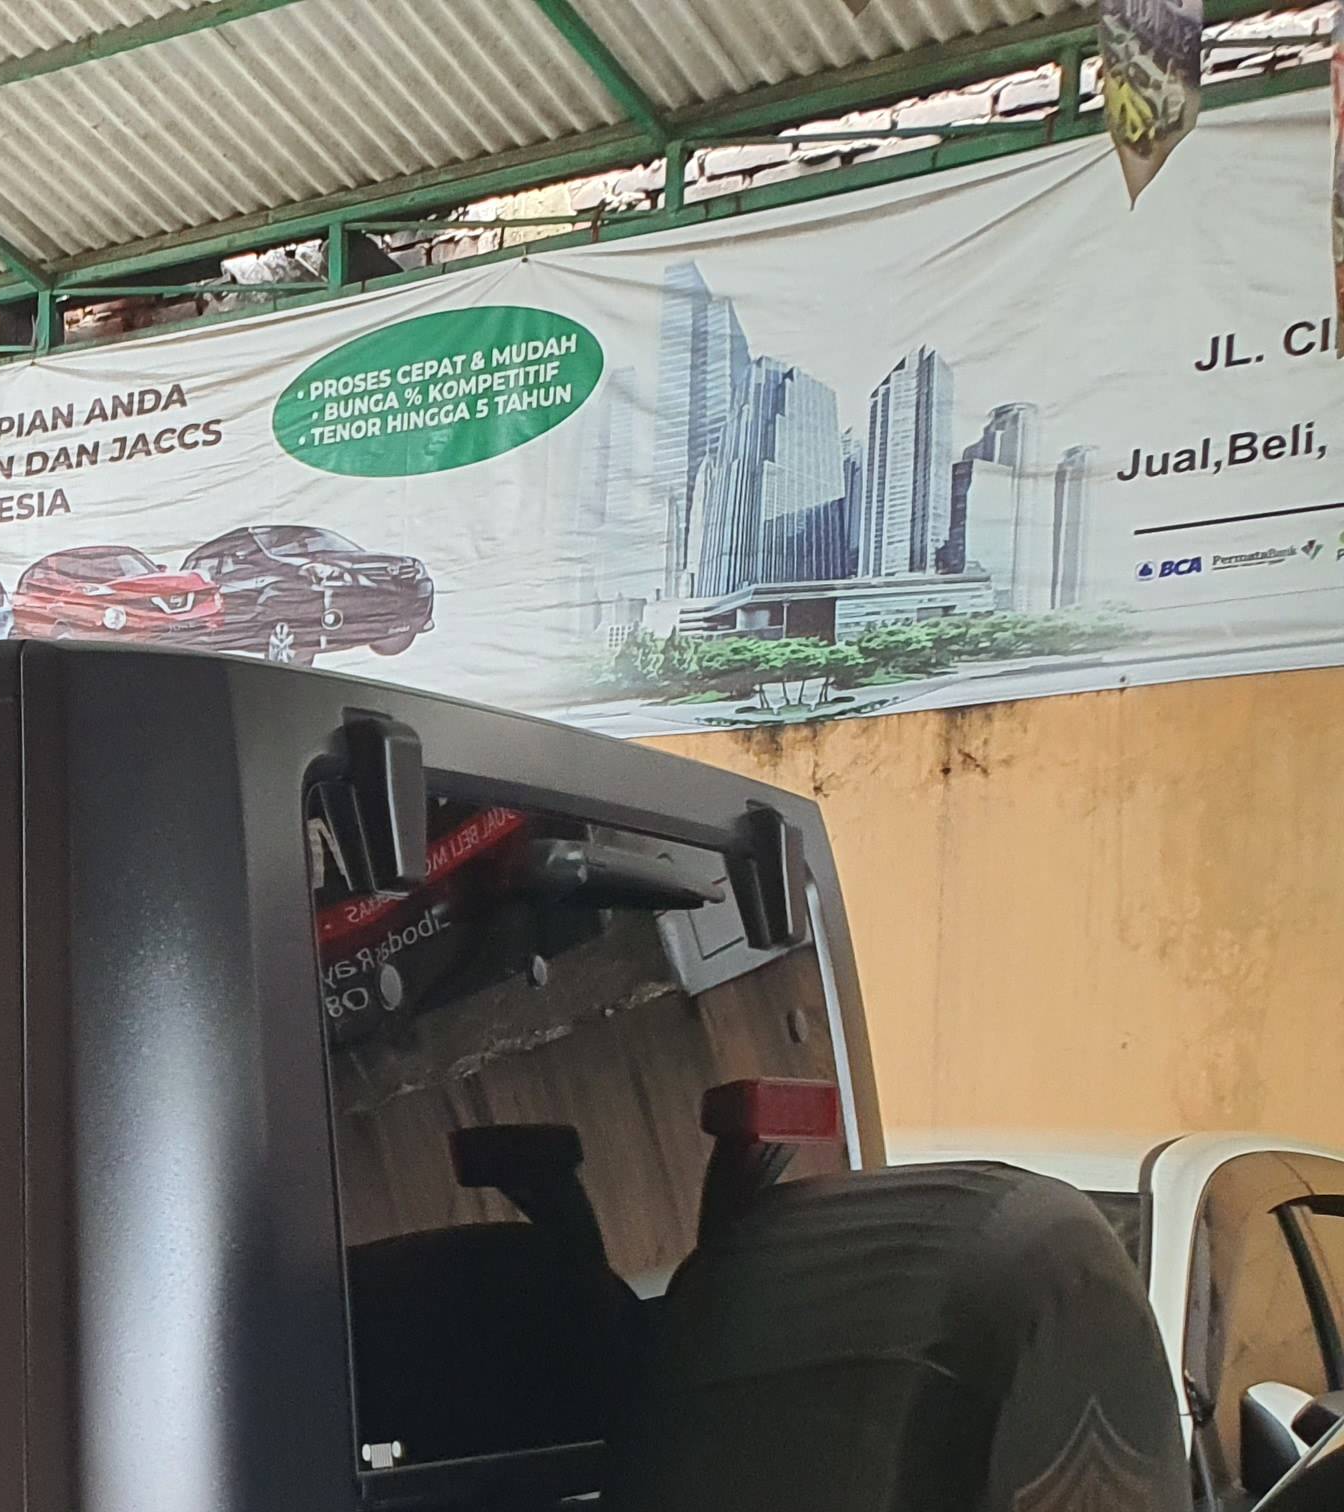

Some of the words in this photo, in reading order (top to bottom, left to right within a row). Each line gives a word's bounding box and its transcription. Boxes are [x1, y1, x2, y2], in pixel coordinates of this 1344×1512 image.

[310, 368, 392, 401] PROSES
[397, 354, 467, 386] CEPAT
[470, 351, 485, 370] &
[492, 333, 578, 367] MUDAH
[1194, 333, 1265, 372] JL.
[1283, 317, 1337, 357] CI
[83, 383, 188, 426] ANDA
[310, 421, 382, 447] TENOR
[387, 401, 471, 434] HINGGA
[475, 397, 489, 419] 5
[494, 384, 572, 416] TAHUN
[323, 391, 400, 422] BUNGA
[404, 386, 422, 406] %
[428, 361, 561, 402] KOMPETITIF
[24, 439, 101, 477] DAN
[108, 418, 224, 464] JACCS
[1158, 556, 1202, 578] BCA
